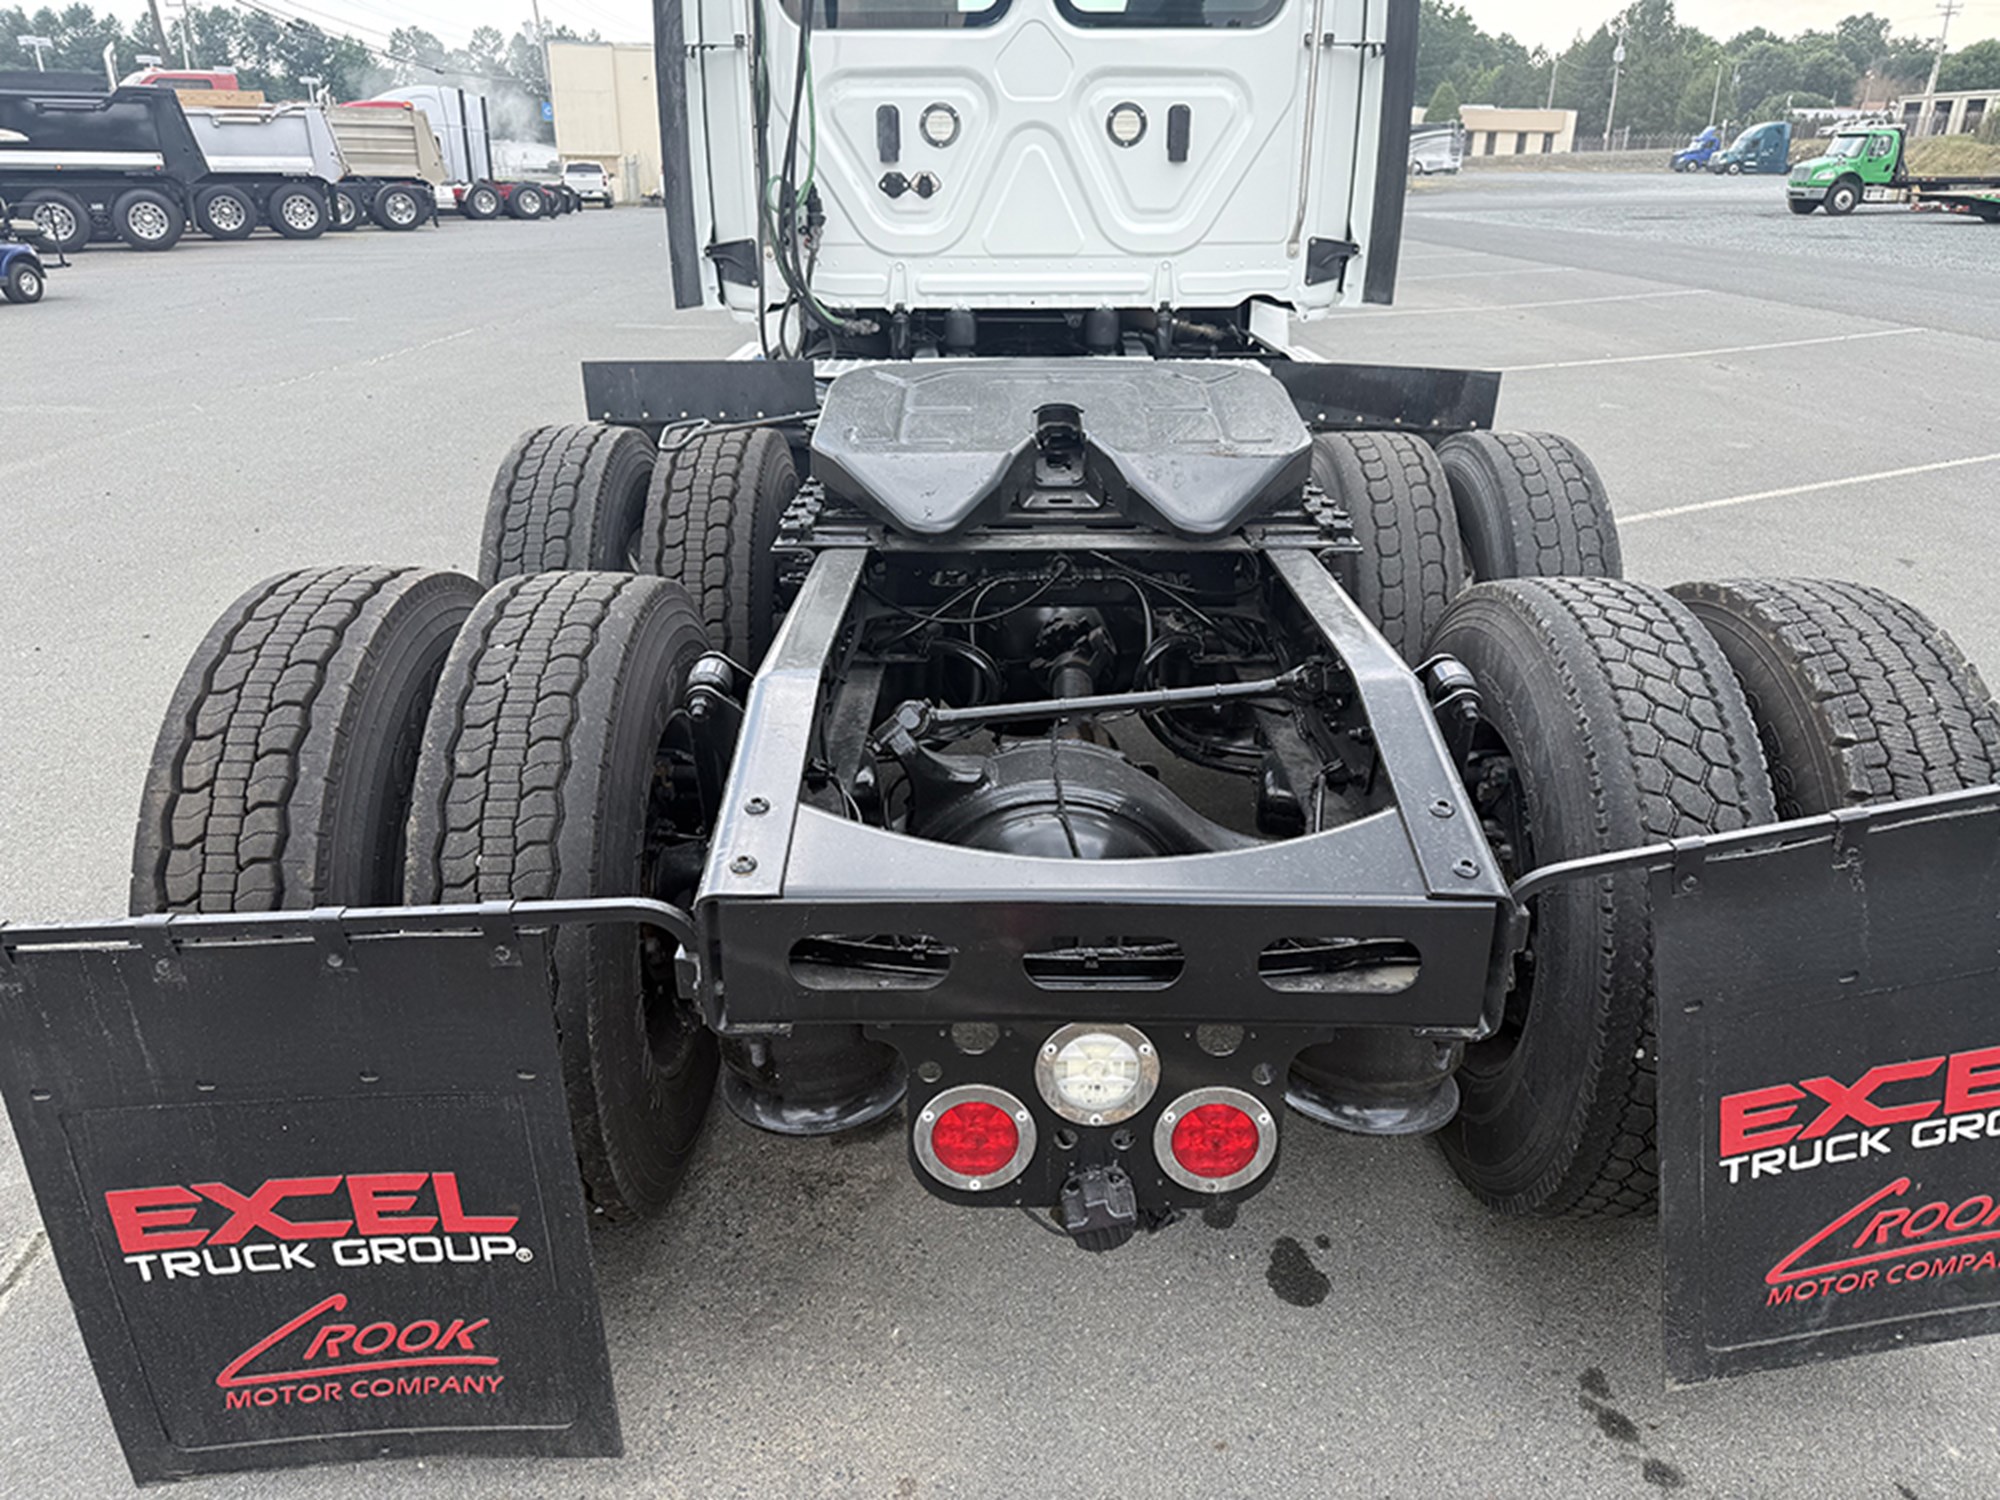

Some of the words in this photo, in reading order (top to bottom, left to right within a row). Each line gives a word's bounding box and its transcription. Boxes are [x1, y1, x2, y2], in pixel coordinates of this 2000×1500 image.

[1719, 1127, 1892, 1184] TRUCK
[104, 1172, 519, 1255] EXCEL
[124, 1242, 316, 1282] TRUCK
[1766, 1270, 1880, 1307] MOTOR
[1885, 1251, 2000, 1285] COMPA
[225, 1383, 343, 1410] MOTOR
[350, 1375, 505, 1400] COMPANY
